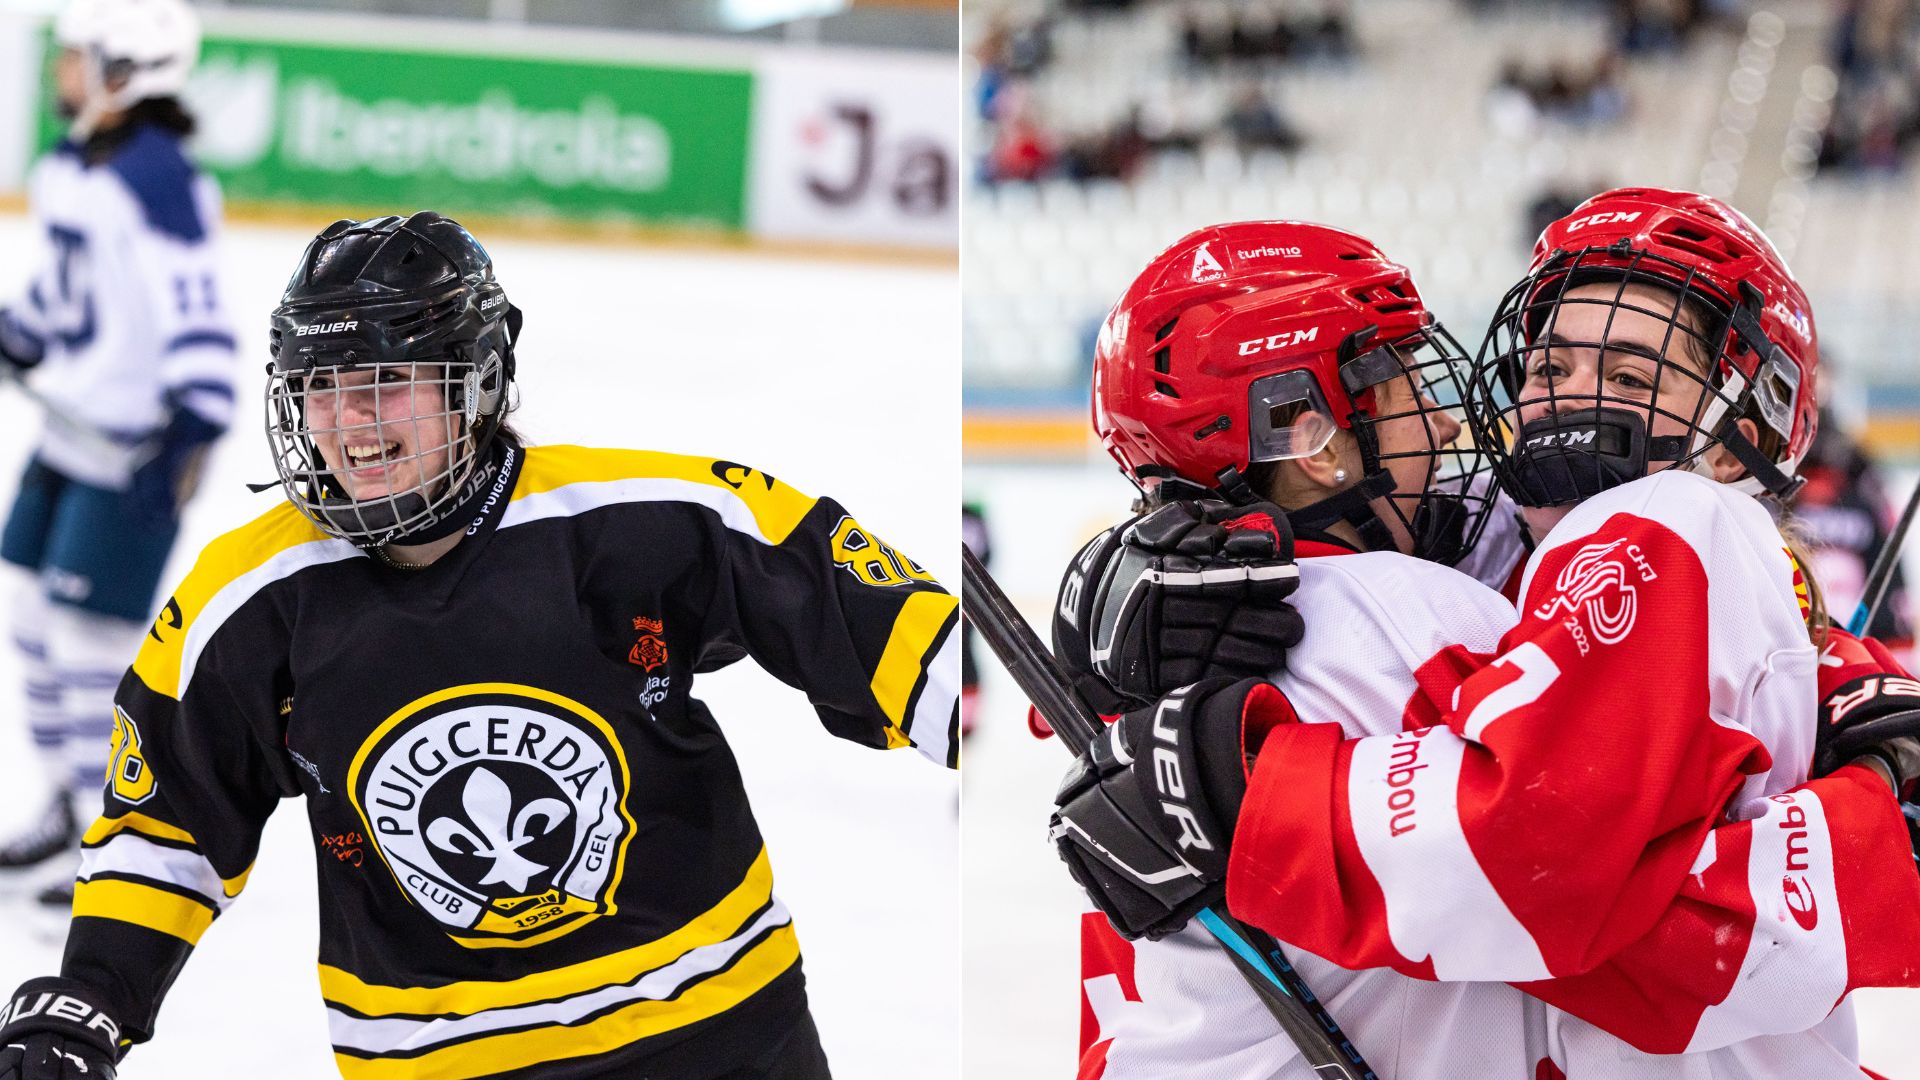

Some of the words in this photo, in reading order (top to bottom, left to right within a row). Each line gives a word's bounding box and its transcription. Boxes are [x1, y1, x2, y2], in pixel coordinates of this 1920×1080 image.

[283, 77, 670, 191] Iberdrola
[1567, 212, 1641, 232] CCM
[1237, 246, 1301, 260] turismo
[481, 293, 505, 312] BAUER
[296, 321, 359, 337] BAUER
[1238, 327, 1319, 356] CCM
[466, 519, 484, 536] CG
[1564, 616, 1590, 657] 2022
[585, 832, 612, 872] GEL
[406, 873, 464, 915] CLUB
[513, 906, 564, 929] 1958
